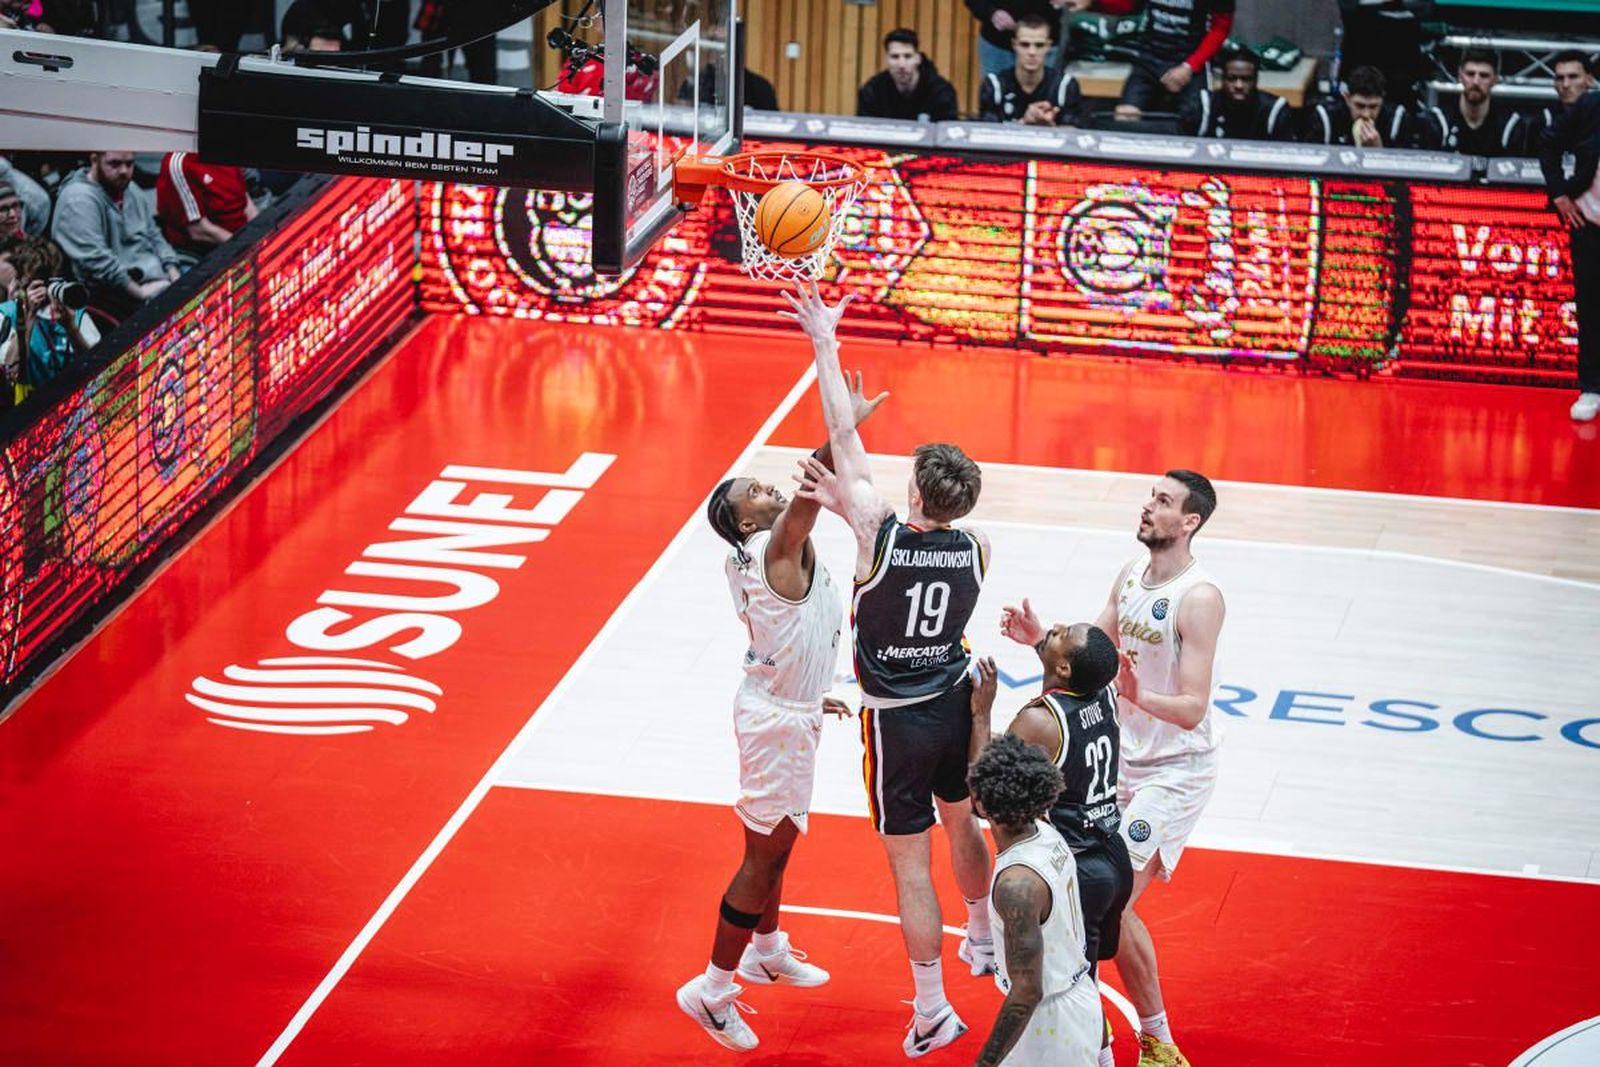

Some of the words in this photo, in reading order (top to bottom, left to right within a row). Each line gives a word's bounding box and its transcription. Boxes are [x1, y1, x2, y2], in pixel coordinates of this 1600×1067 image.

[297, 126, 514, 163] spindler
[338, 156, 402, 167] WILLKOMMEN
[405, 161, 429, 169] BEIM
[431, 163, 469, 172] BESTEN
[471, 166, 499, 175] TEAM
[1453, 224, 1560, 277] Von
[1451, 294, 1542, 344] Mit
[286, 452, 617, 659] SUNEL
[891, 548, 972, 568] SKLADANOWSKI
[905, 581, 951, 637] 19
[910, 652, 949, 668] LEASING
[1079, 702, 1104, 730] STOVE
[1085, 735, 1117, 805] 22
